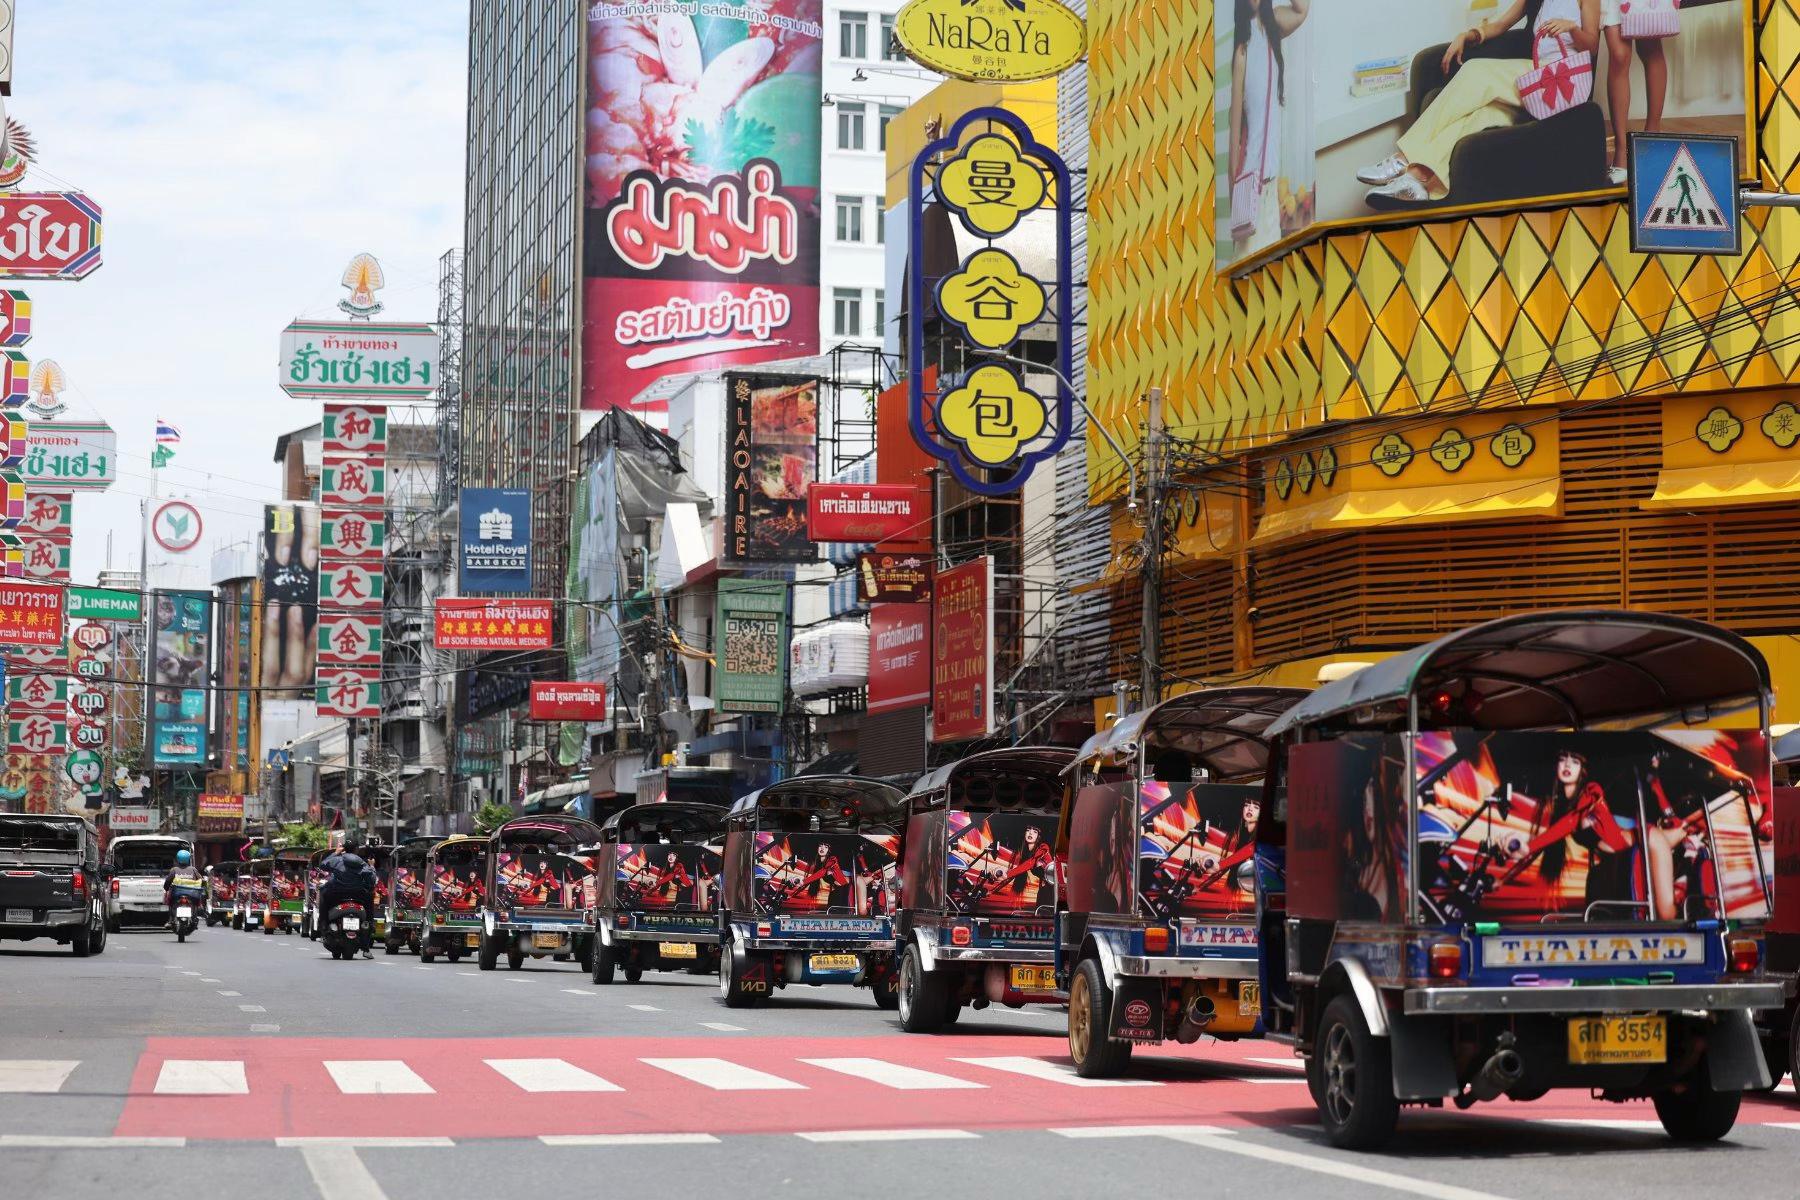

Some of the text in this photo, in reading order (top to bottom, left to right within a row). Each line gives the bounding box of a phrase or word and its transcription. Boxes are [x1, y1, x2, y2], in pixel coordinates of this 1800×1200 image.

[926, 12, 1052, 56] NaRaYa
[608, 164, 798, 274] มาม่า
[615, 287, 792, 347] รสต้มยำกุ้ง
[289, 341, 431, 385] ฮั่วเซ่งเฮง
[465, 544, 527, 556] Hotel Royal
[84, 598, 138, 611] LINE MAN
[470, 637, 488, 646] HENG
[489, 637, 518, 646] NATURAL
[518, 637, 548, 646] MEDICINE
[790, 919, 873, 931] THAILAND
[1502, 937, 1687, 965] THAILAND
[1578, 1018, 1662, 1043] สก 3554
